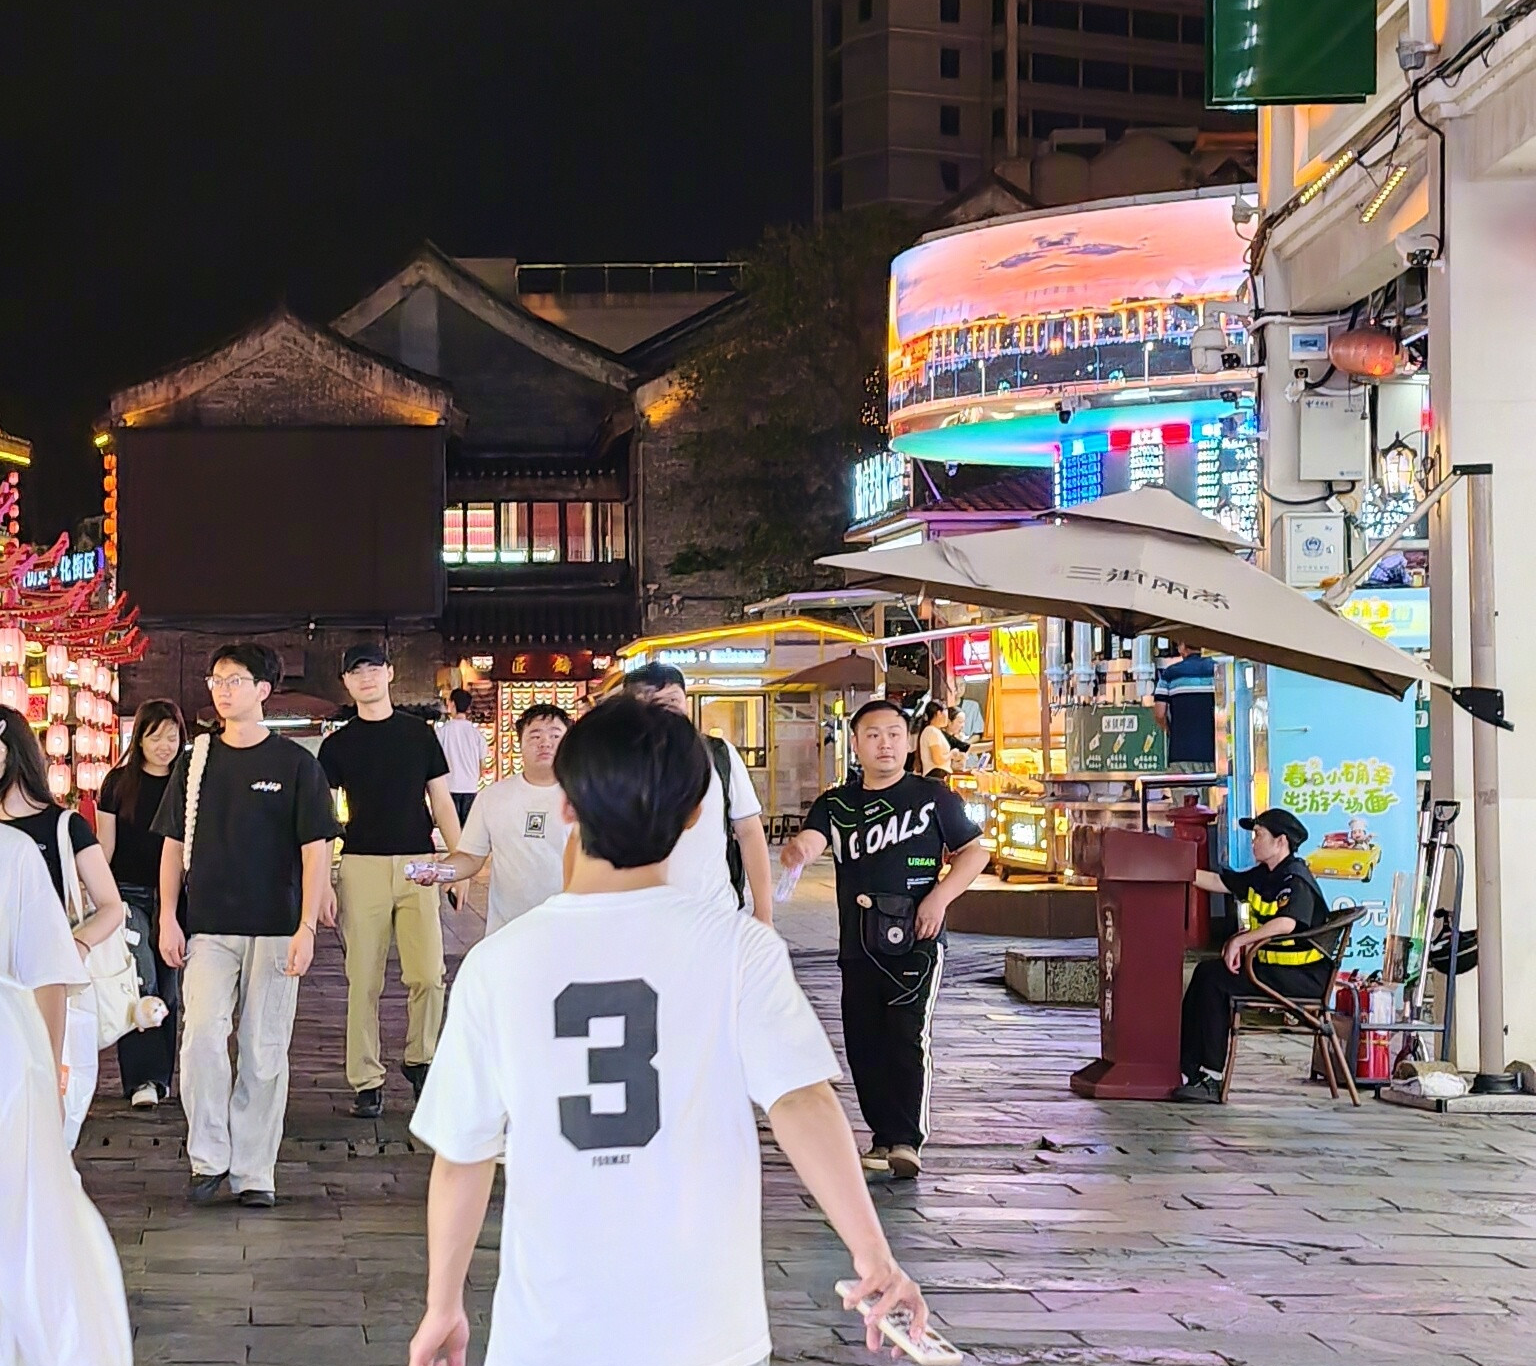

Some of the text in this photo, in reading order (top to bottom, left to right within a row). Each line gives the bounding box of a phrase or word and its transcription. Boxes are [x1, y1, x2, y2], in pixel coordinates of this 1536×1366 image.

[1282, 788, 1399, 815] 出游大场面
[554, 977, 660, 1151] 3
